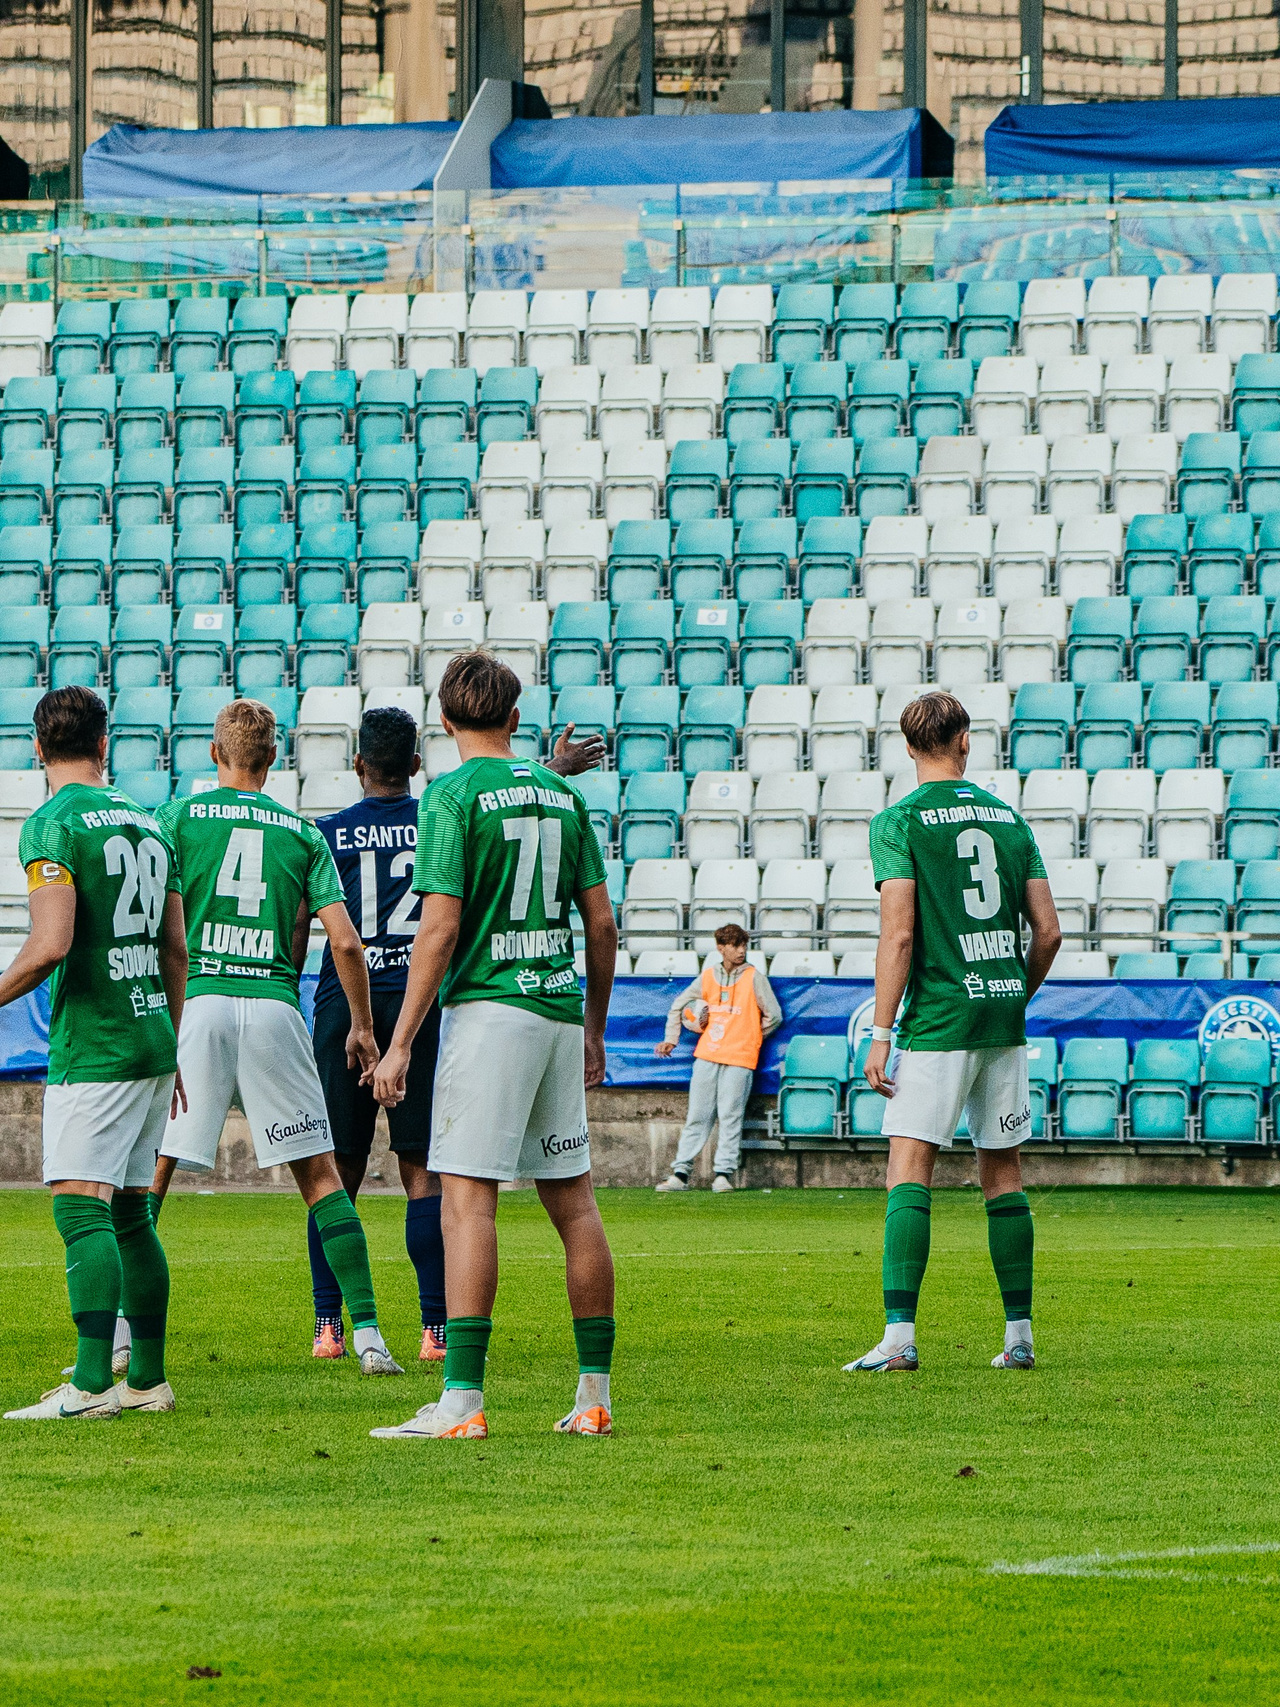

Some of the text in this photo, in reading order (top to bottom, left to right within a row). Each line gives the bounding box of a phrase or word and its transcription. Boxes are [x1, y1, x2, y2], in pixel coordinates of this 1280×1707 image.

[478, 792, 498, 812] FC
[496, 786, 536, 808] FLORA
[920, 805, 1016, 825] FC FLORA TALLINN
[81, 811, 102, 829] FC
[97, 809, 135, 826] FLORA
[190, 804, 301, 833] FC FLORA TALLINN
[42, 863, 60, 877] C
[216, 827, 267, 917] 4
[502, 816, 562, 920] 71
[956, 828, 1001, 920] 3
[103, 835, 168, 938] 28
[360, 851, 421, 939] 12
[201, 922, 274, 960] LUKKA
[958, 930, 1016, 962] VAHER
[987, 979, 1023, 993] SELVER
[1218, 1002, 1269, 1022] EESTI
[264, 1113, 328, 1146] Krausberg
